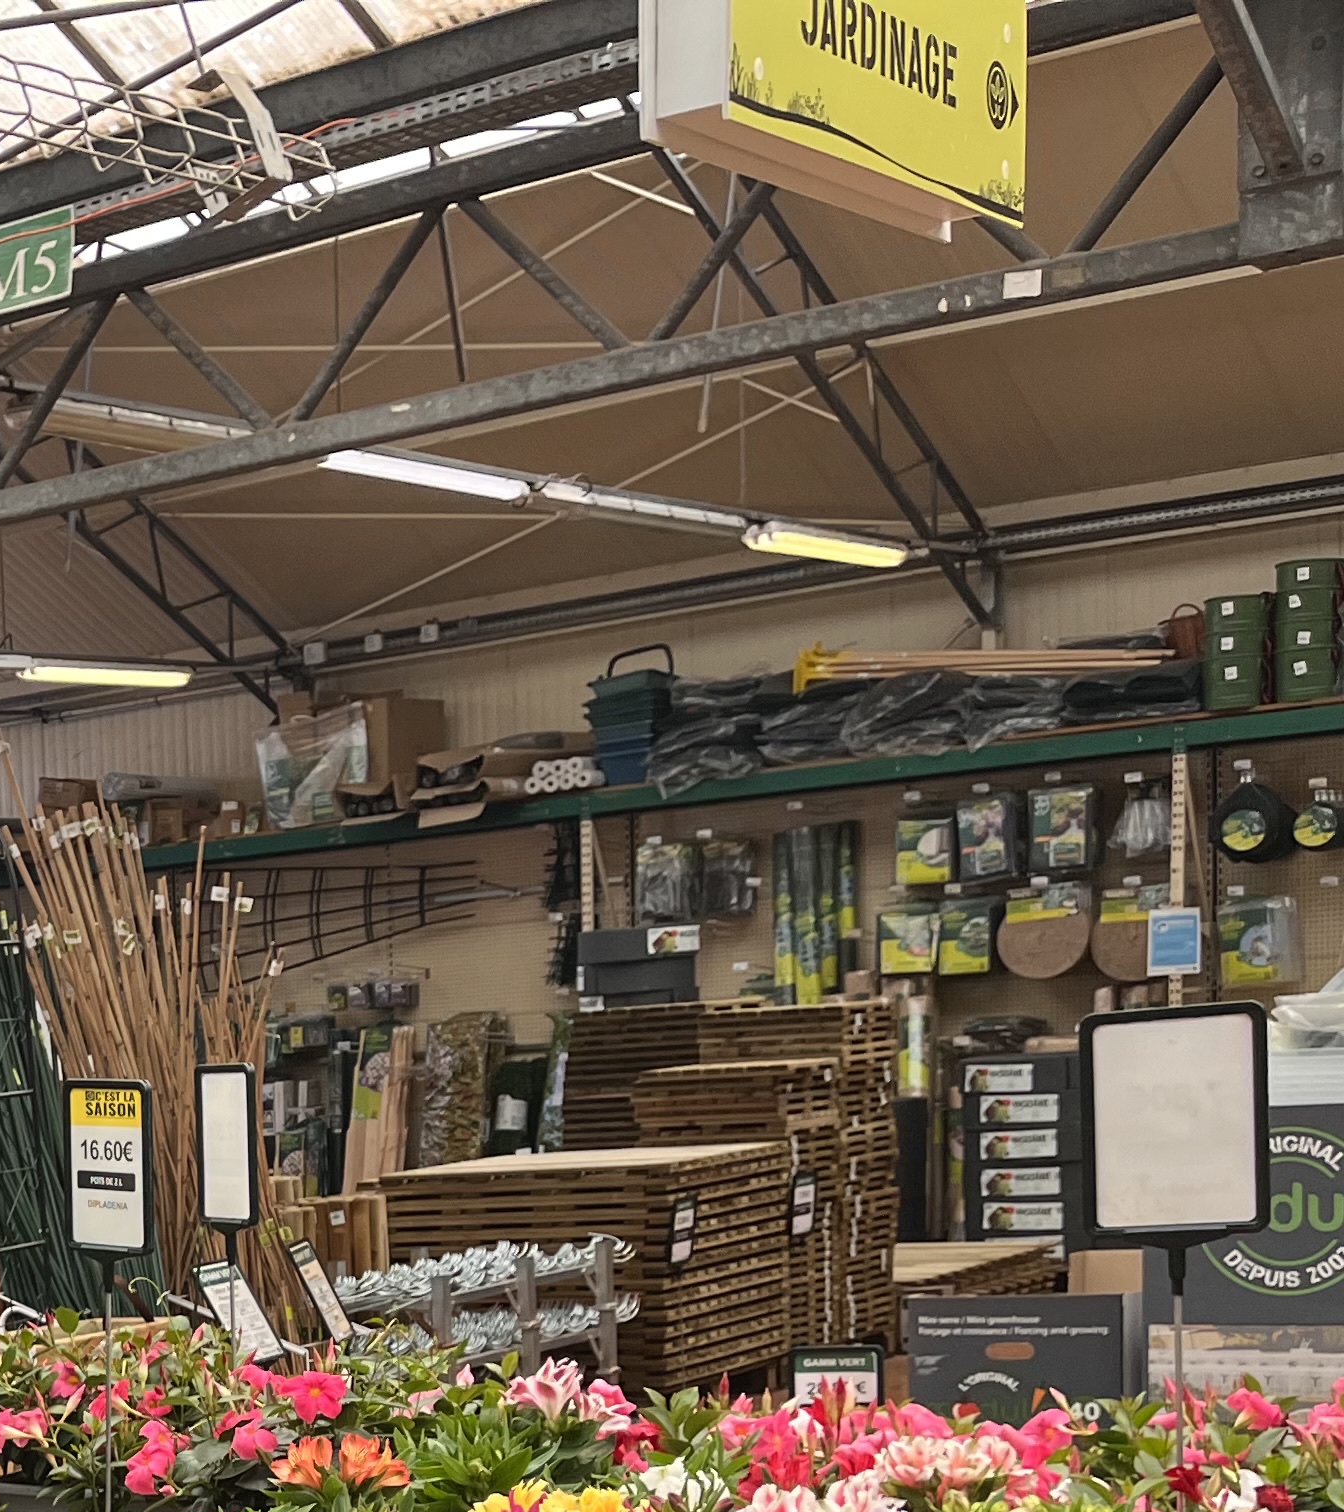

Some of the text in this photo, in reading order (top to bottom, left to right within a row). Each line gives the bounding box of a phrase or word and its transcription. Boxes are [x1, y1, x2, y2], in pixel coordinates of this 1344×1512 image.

[800, 0, 958, 109] JARDINAGE
[95, 1090, 136, 1103] C'EST LA
[85, 1101, 137, 1118] SAISON
[79, 1139, 134, 1162] 16.60€
[1222, 1248, 1302, 1289] DEPUIS
[1049, 1326, 1068, 1335] and
[837, 1357, 866, 1367] VERT
